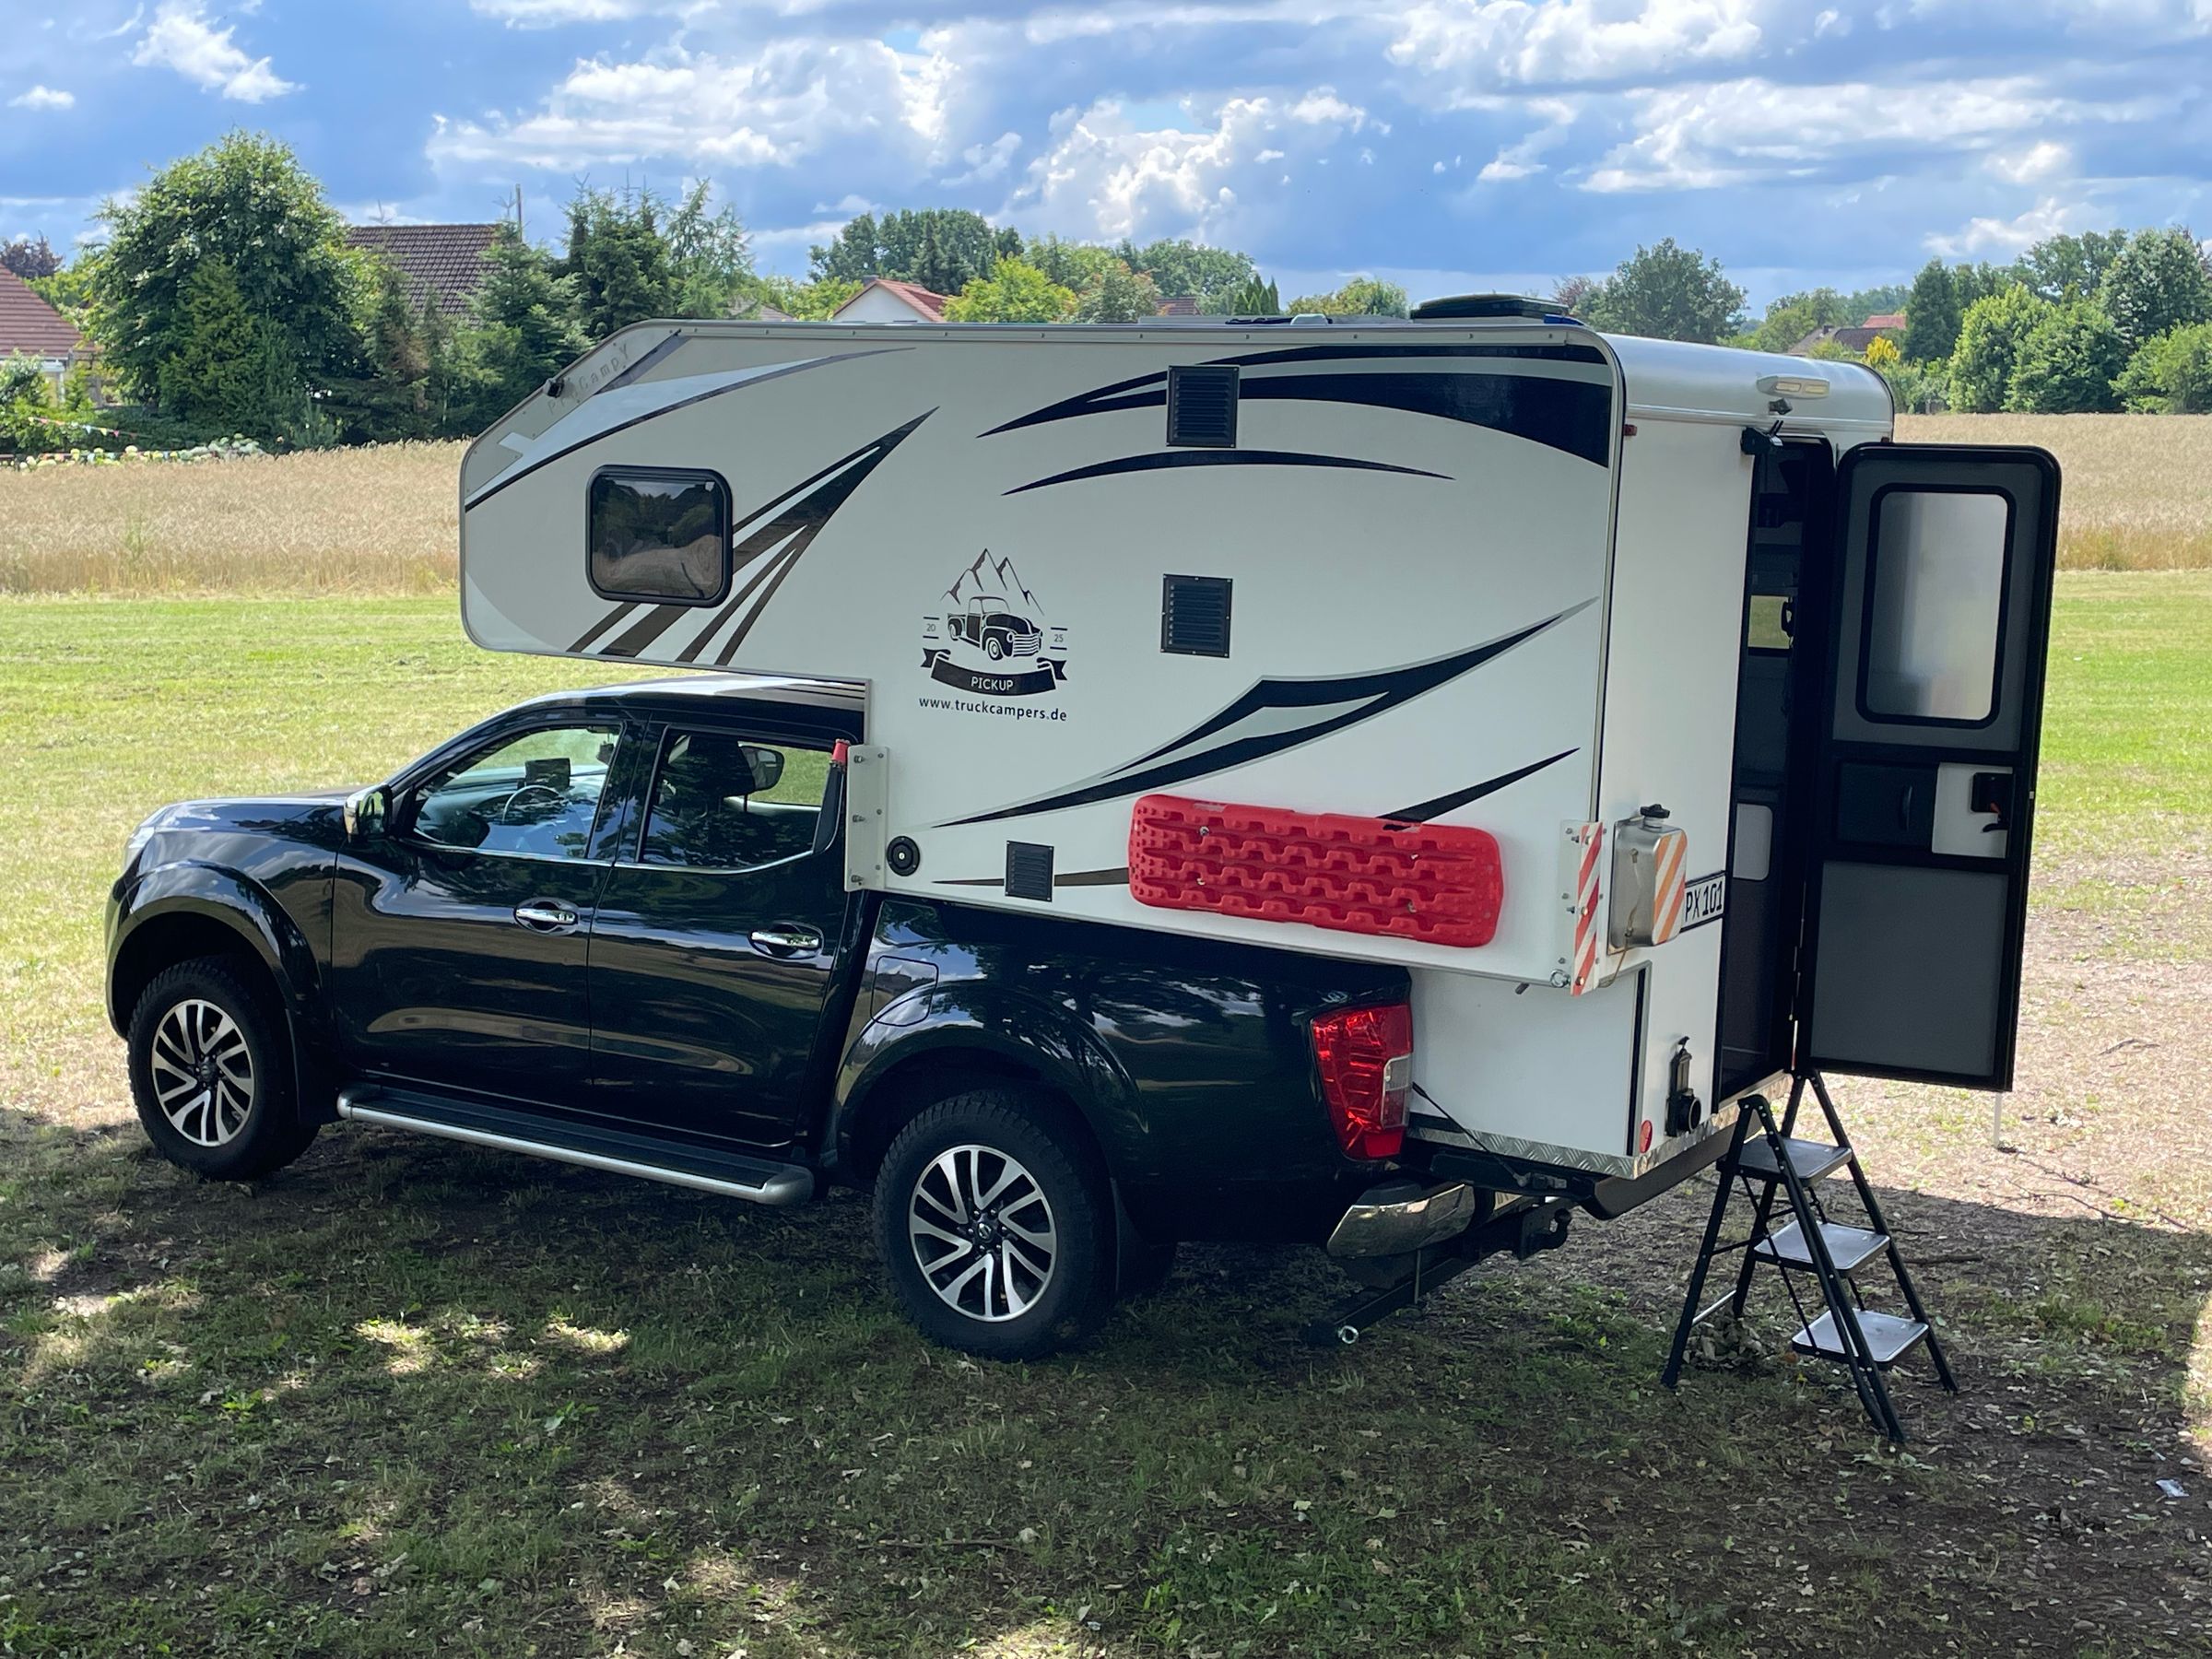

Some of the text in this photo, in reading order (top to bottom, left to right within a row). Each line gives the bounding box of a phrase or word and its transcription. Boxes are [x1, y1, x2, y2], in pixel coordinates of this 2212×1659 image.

[925, 622, 936, 633] 20
[1053, 633, 1065, 644] 25
[971, 676, 1014, 691] PICKUP
[919, 697, 1067, 721] www.truckcampers.de
[1685, 880, 1723, 922] PX 101
